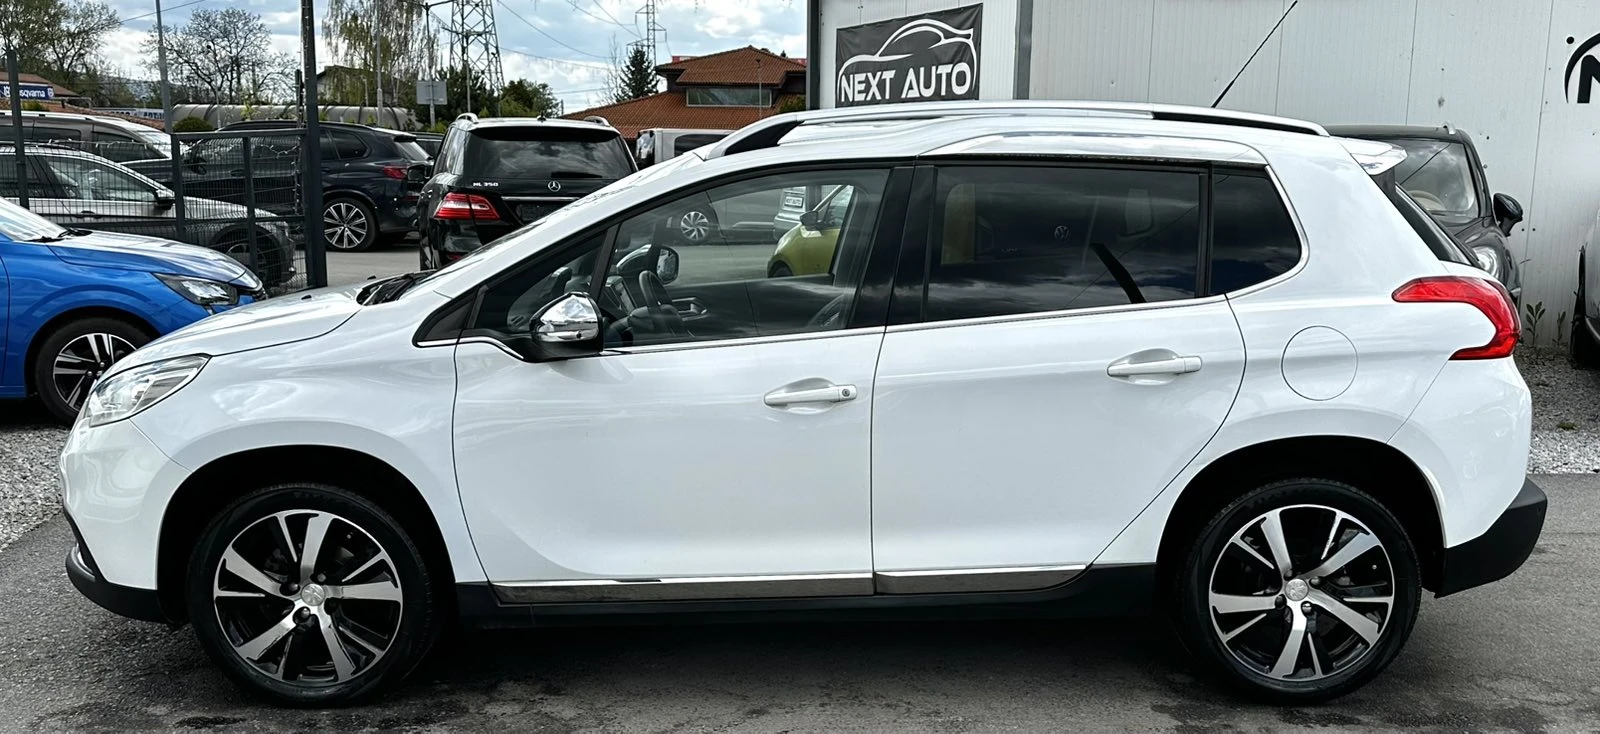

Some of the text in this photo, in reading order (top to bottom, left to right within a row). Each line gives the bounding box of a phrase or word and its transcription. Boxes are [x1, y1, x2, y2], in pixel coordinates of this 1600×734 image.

[13, 88, 46, 98] sqvarna
[840, 62, 971, 102] NEXT AUTO
